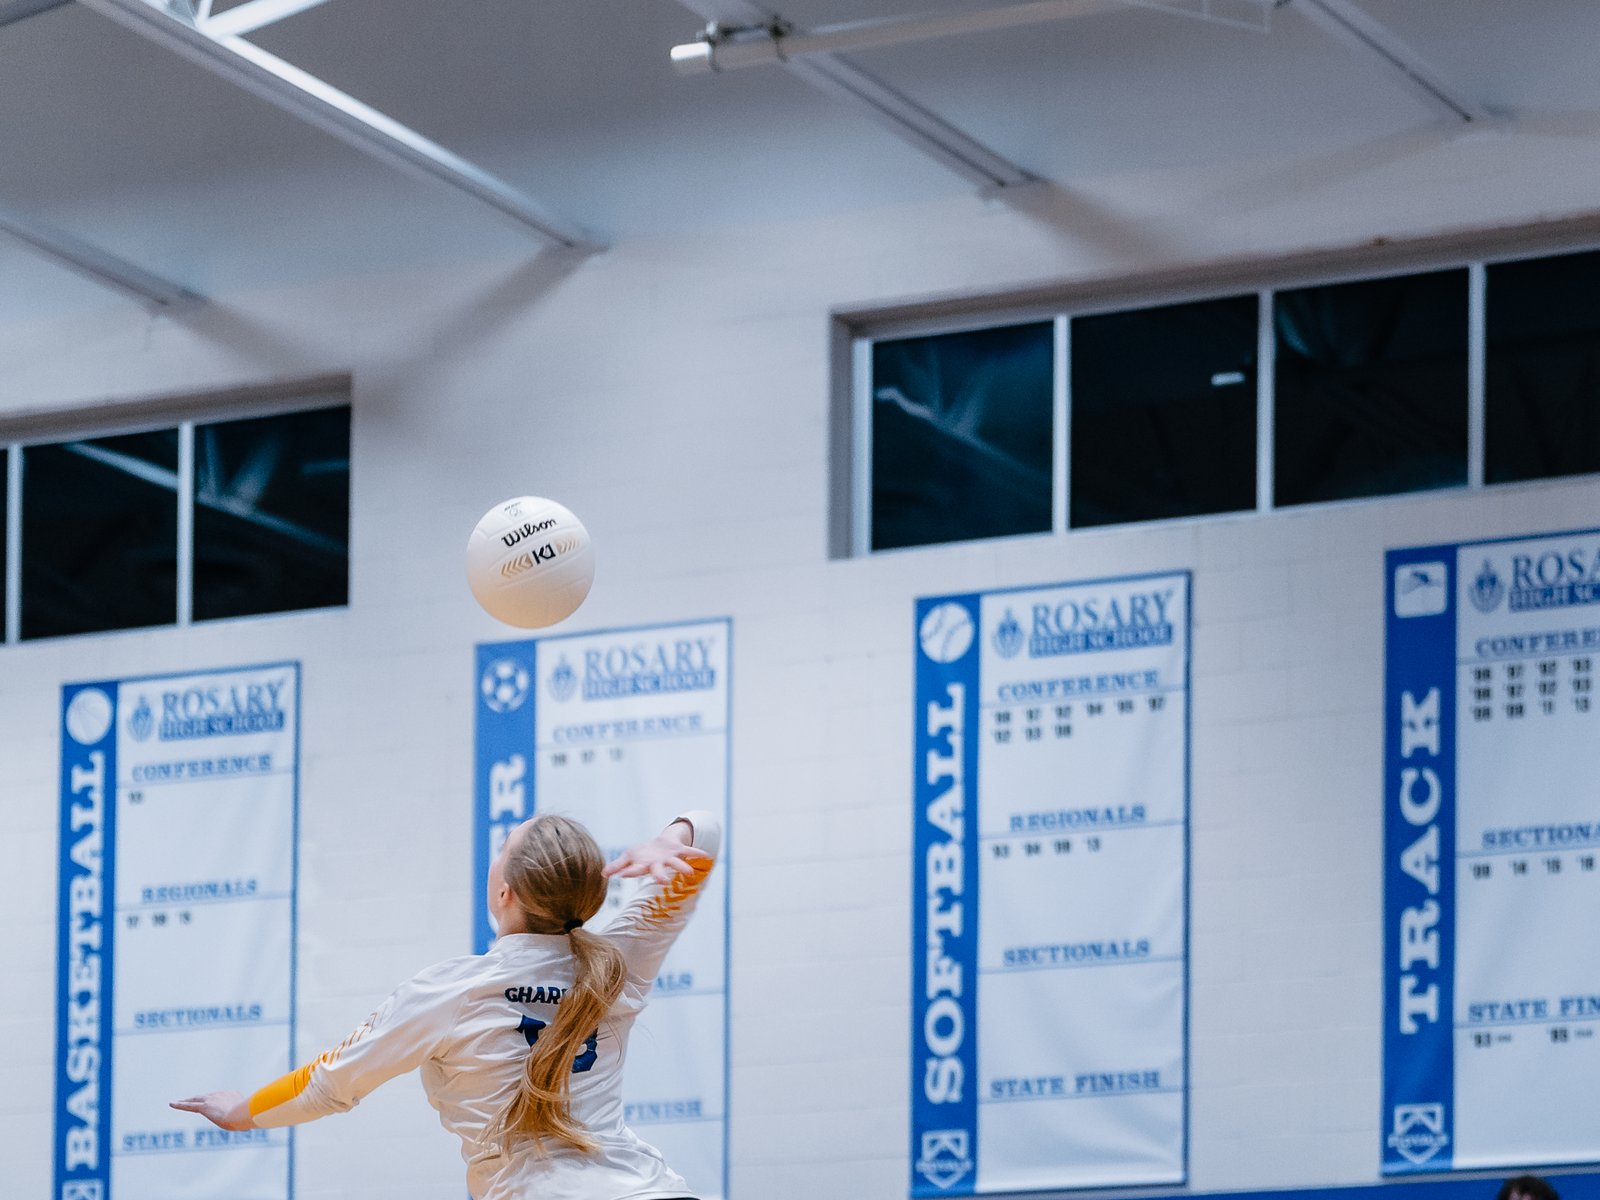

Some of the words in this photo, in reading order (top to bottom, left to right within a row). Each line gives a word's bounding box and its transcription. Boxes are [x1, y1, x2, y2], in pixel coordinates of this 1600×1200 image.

[501, 519, 557, 547] Wilson
[1032, 590, 1174, 636] ROSARY
[583, 640, 713, 680] ROSARY
[998, 670, 1158, 699] CONFERENCE
[161, 681, 285, 722] ROSARY
[553, 713, 702, 743] CONFERENCE
[132, 754, 272, 781] CONFERENCE
[1010, 805, 1146, 832] REGIONALS
[1400, 687, 1441, 1035] TRACK
[142, 880, 257, 903] REGIONALS
[925, 683, 965, 1104] SOFTBALL
[66, 751, 105, 1172] BASKETBALL
[1003, 939, 1150, 965] SECTIONALS
[134, 1005, 262, 1029] SECTIONALS
[1470, 1000, 1546, 1022] STATE
[990, 1074, 1064, 1097] STATE
[1074, 1071, 1160, 1094] FINISH
[623, 1101, 702, 1122] FINISH
[122, 1132, 184, 1151] STATE
